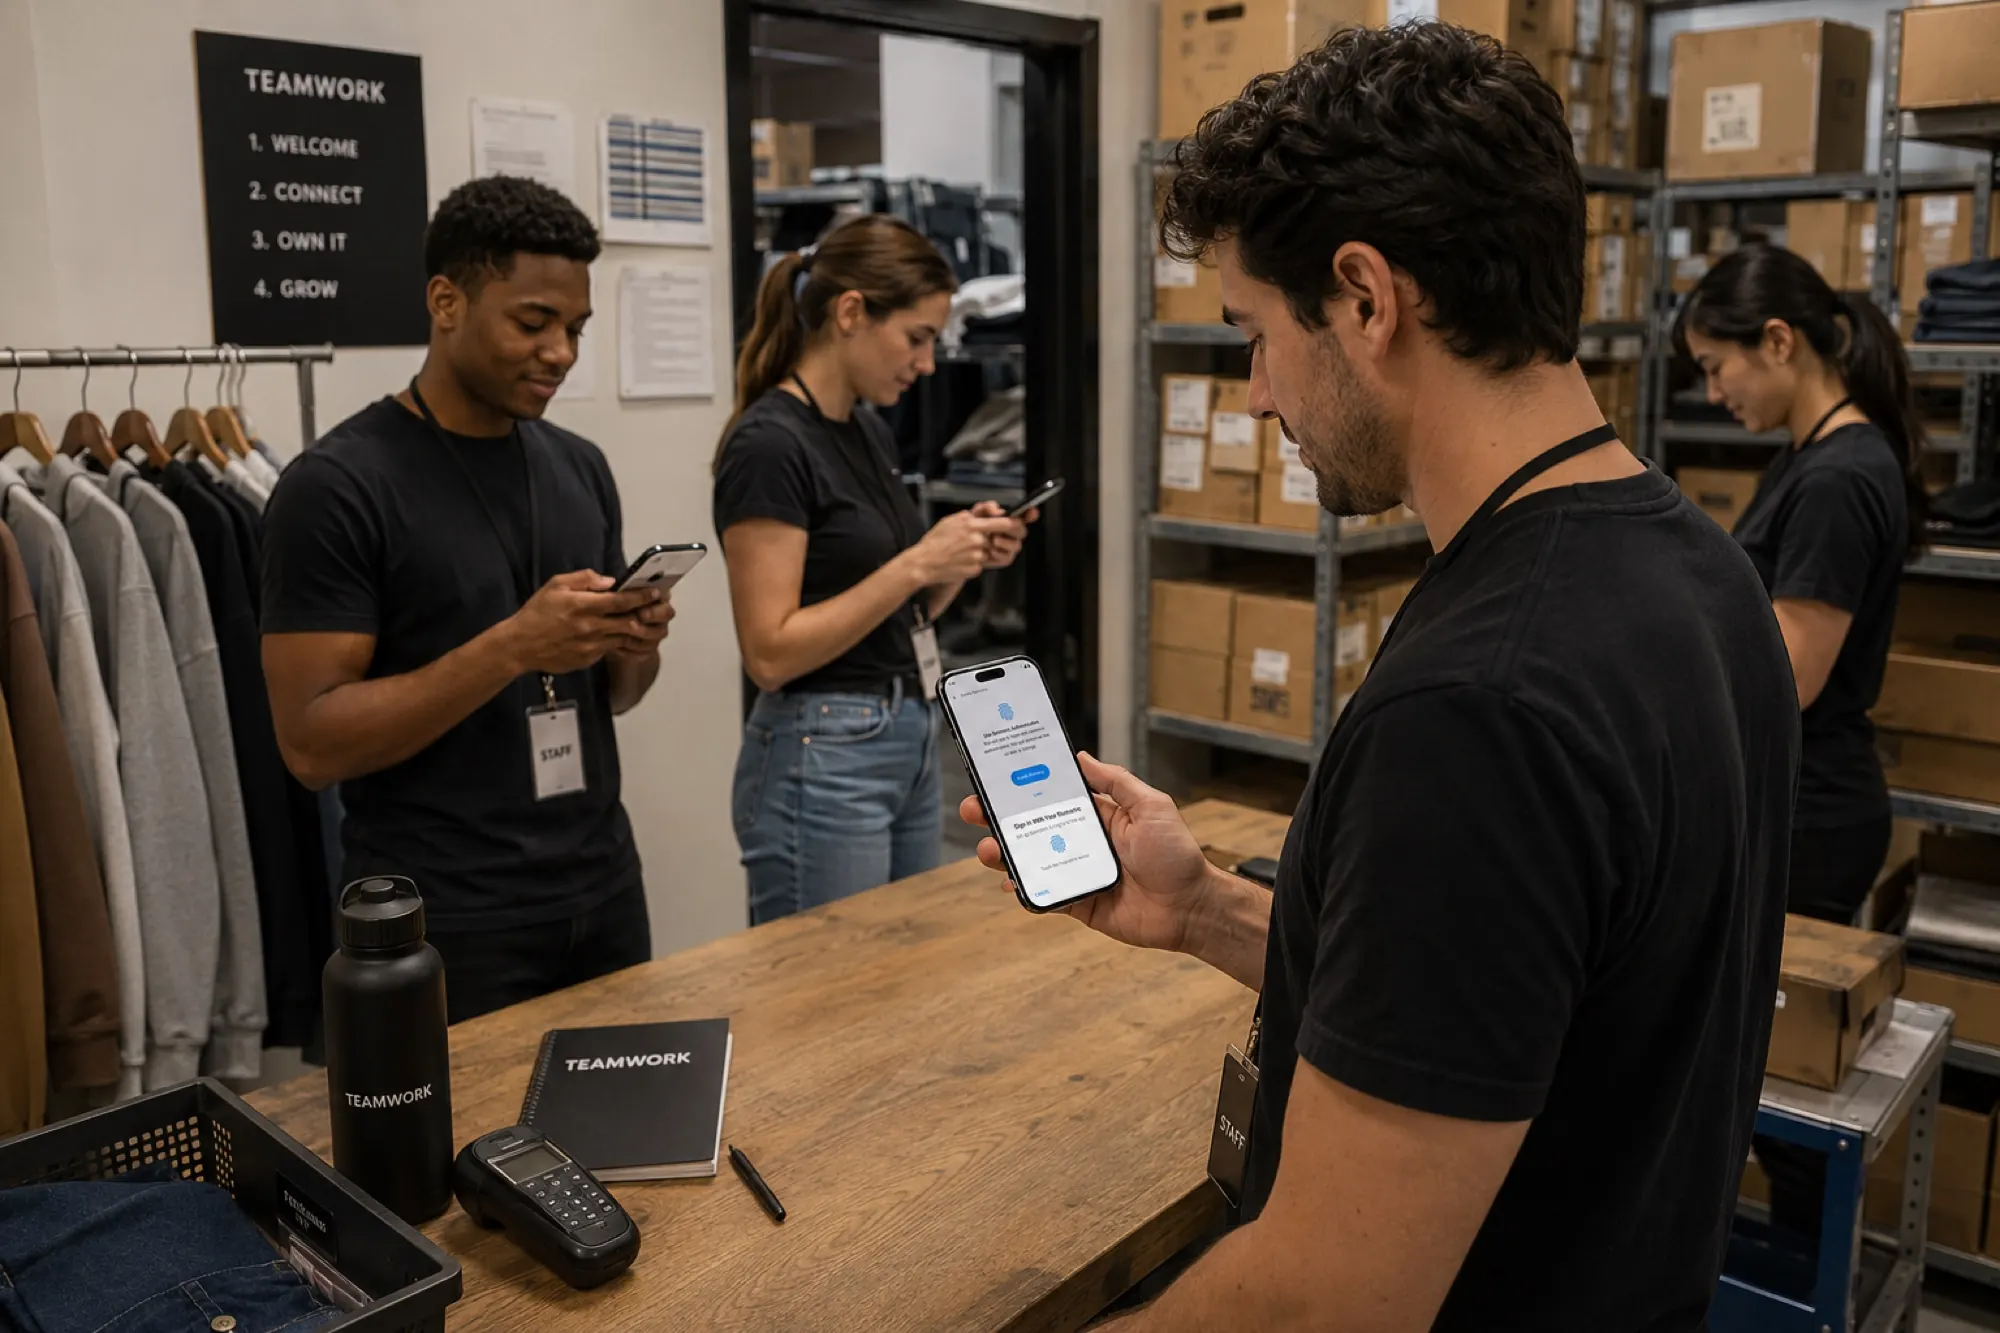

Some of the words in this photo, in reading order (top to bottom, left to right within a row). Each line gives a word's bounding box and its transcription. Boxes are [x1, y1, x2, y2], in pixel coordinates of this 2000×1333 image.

[244, 68, 386, 104] TEAMWORK
[249, 132, 263, 151] 1.
[271, 134, 358, 158] WELCOME
[249, 180, 267, 200] 2.
[274, 182, 363, 205] CONNECT
[252, 229, 270, 250] 3.
[278, 231, 325, 250] OWN
[329, 232, 347, 251] IT
[253, 279, 272, 298] 4.
[280, 279, 338, 298] GROW
[540, 744, 572, 762] STAFF
[566, 1051, 691, 1071] TEAMWORK
[346, 1083, 432, 1109] TEAMWORK
[1219, 1115, 1246, 1150] STAFF
